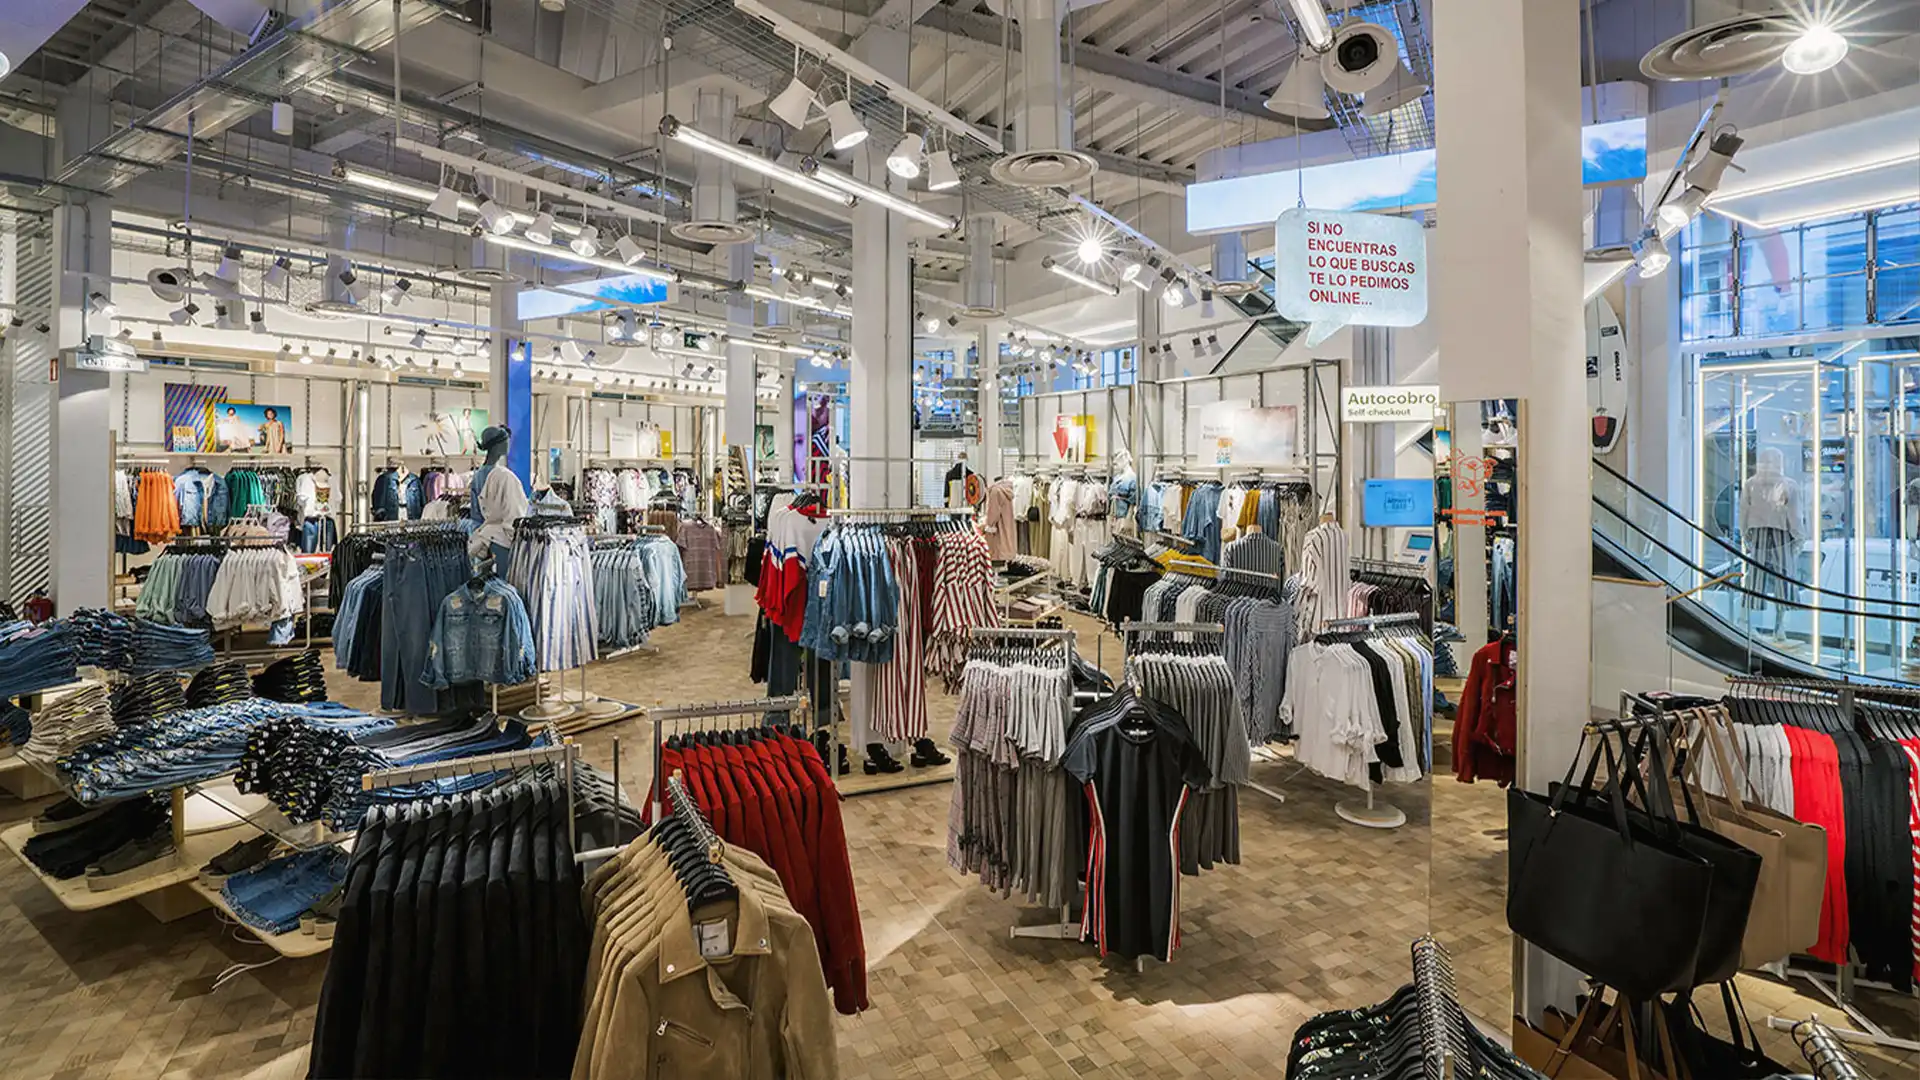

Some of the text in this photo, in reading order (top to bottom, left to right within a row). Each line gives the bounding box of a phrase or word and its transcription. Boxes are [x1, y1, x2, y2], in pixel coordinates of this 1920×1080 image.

[1308, 221, 1343, 236] SI NO
[1308, 238, 1397, 257] ENCUENTRAS
[1308, 255, 1416, 275] LO QUE BUSCAS
[1309, 272, 1410, 291] TE LO PEDIMOS
[1309, 289, 1373, 305] ONLINE...
[1347, 391, 1437, 405] Autocobro
